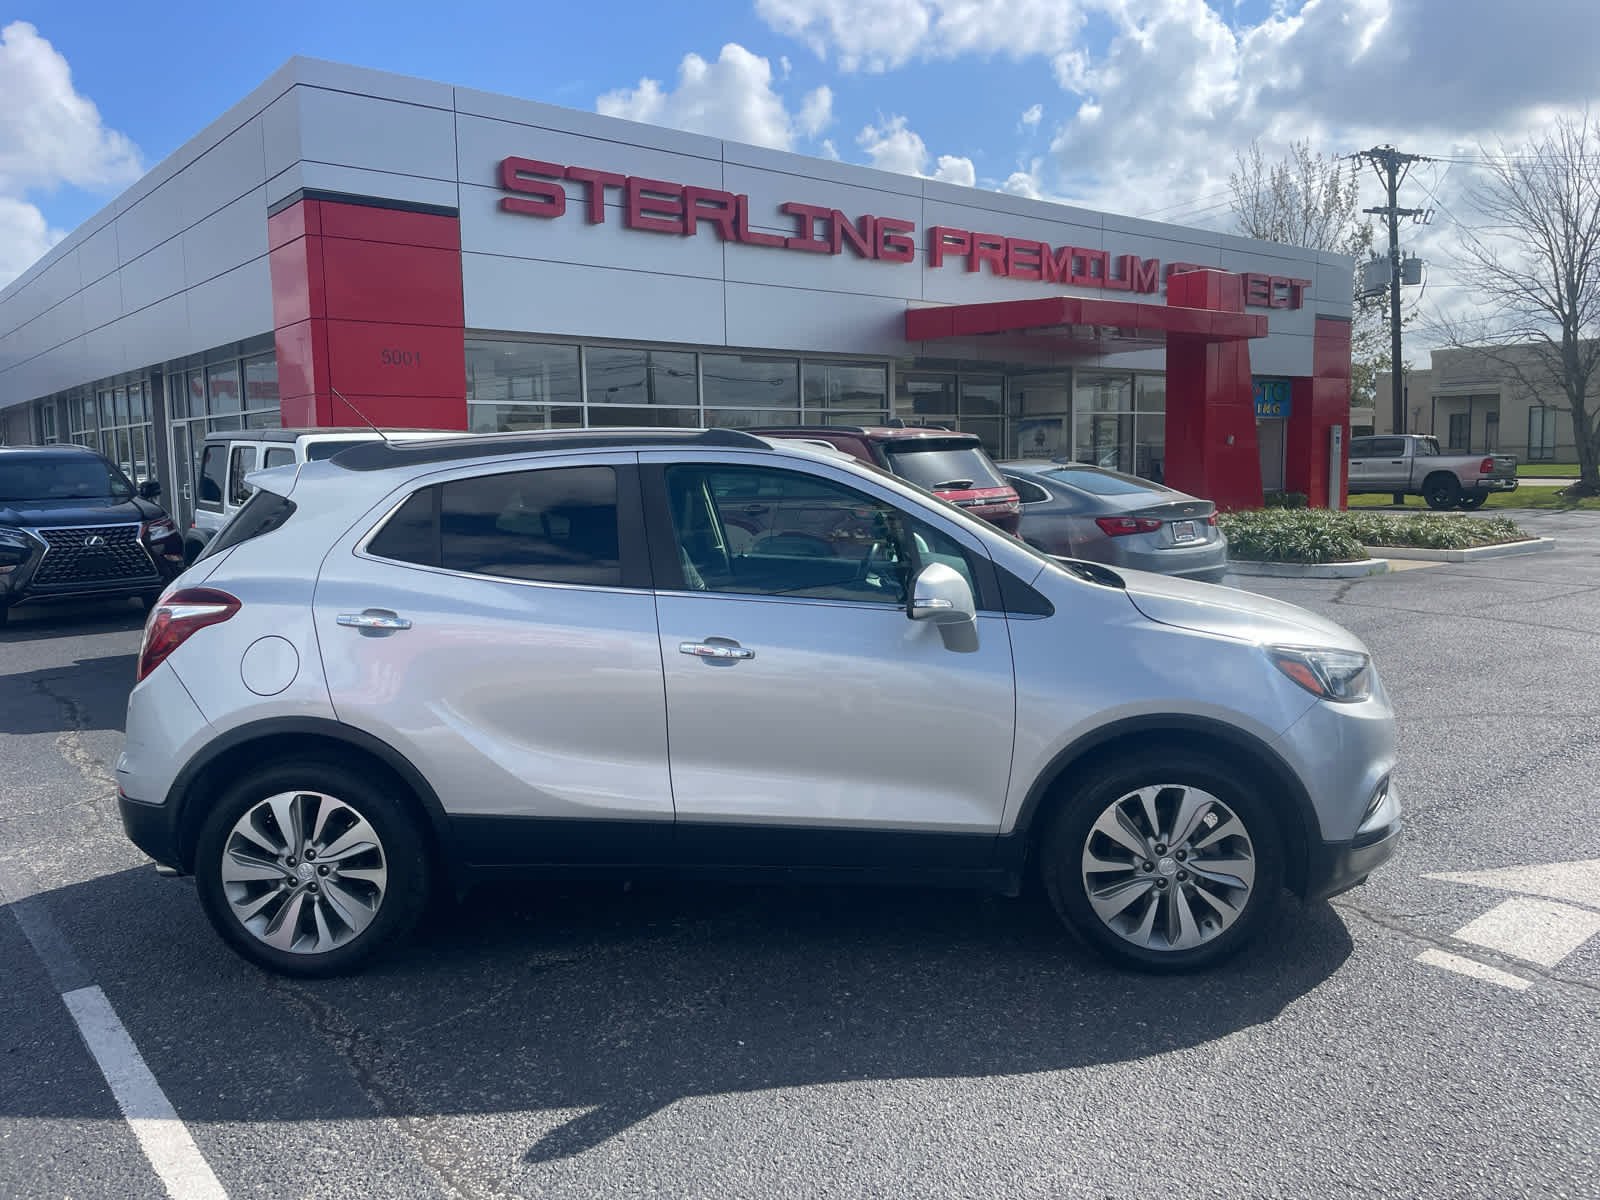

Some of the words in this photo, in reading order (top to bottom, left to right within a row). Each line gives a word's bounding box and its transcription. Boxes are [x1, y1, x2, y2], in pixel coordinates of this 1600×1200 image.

[498, 156, 915, 263] STERLING
[928, 225, 1160, 294] PREMIUM
[1164, 262, 1313, 310] ECT
[381, 348, 421, 366] 5001
